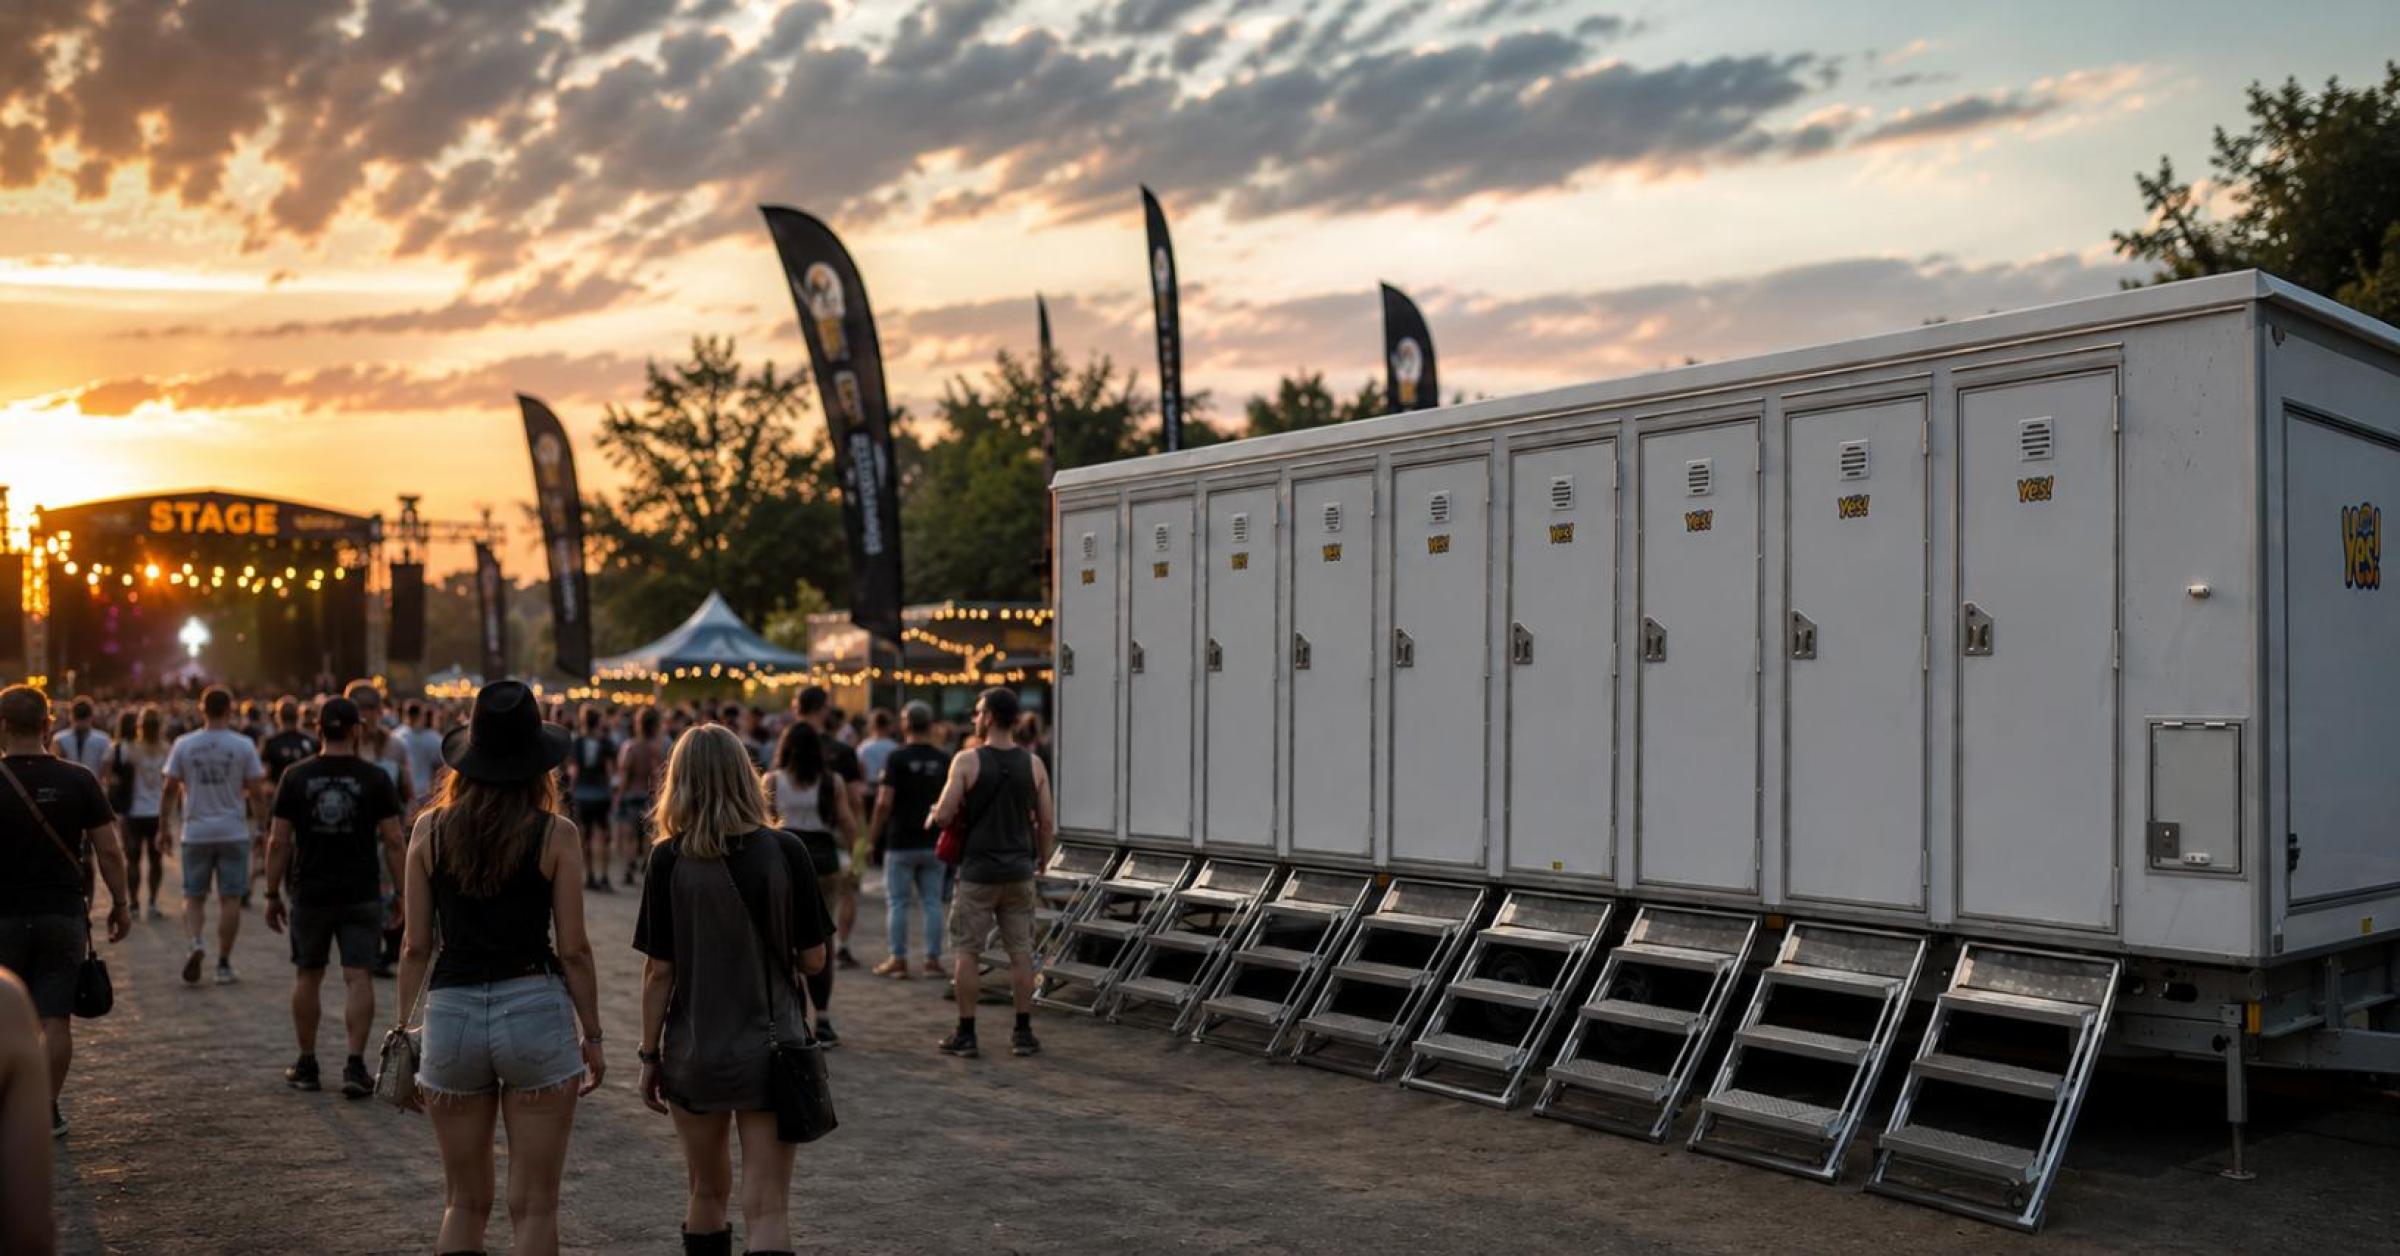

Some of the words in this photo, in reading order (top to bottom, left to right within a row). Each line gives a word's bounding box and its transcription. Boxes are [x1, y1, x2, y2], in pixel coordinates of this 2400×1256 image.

[2017, 476, 2054, 503] Yes!
[151, 501, 279, 535] STAGE
[1838, 495, 1870, 519] Yes!
[2342, 502, 2382, 589] Yes!
